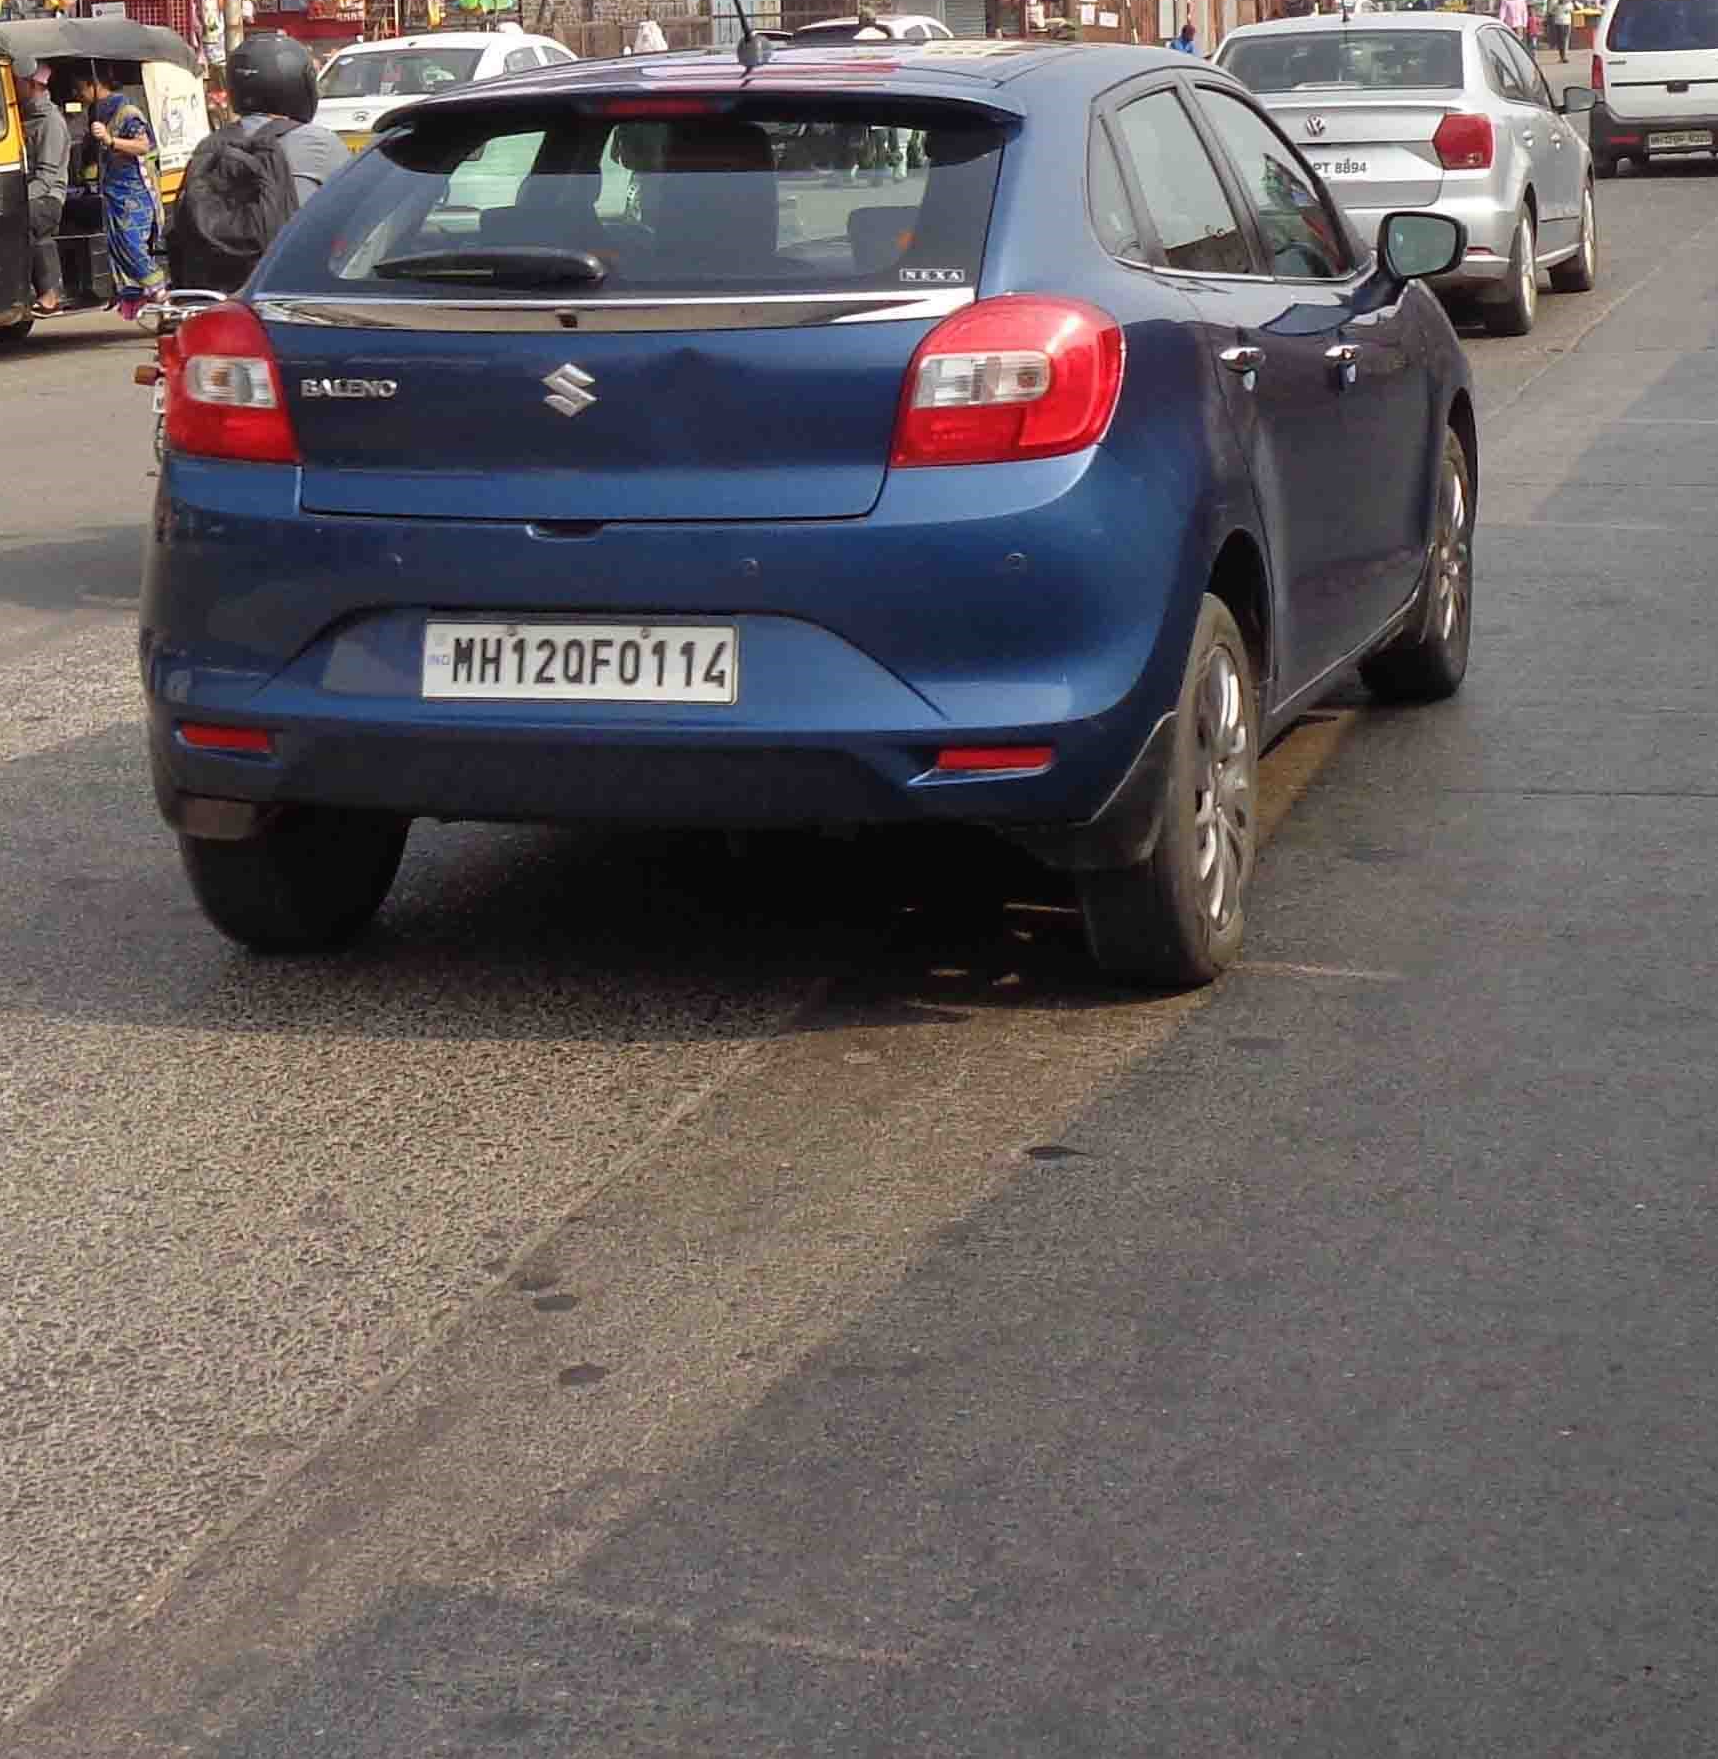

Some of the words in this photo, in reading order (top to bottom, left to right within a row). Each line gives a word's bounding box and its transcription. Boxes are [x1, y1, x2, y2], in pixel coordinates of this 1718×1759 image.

[1334, 160, 1367, 175] 8894
[904, 269, 963, 282] NEXA
[300, 377, 398, 399] BALENO
